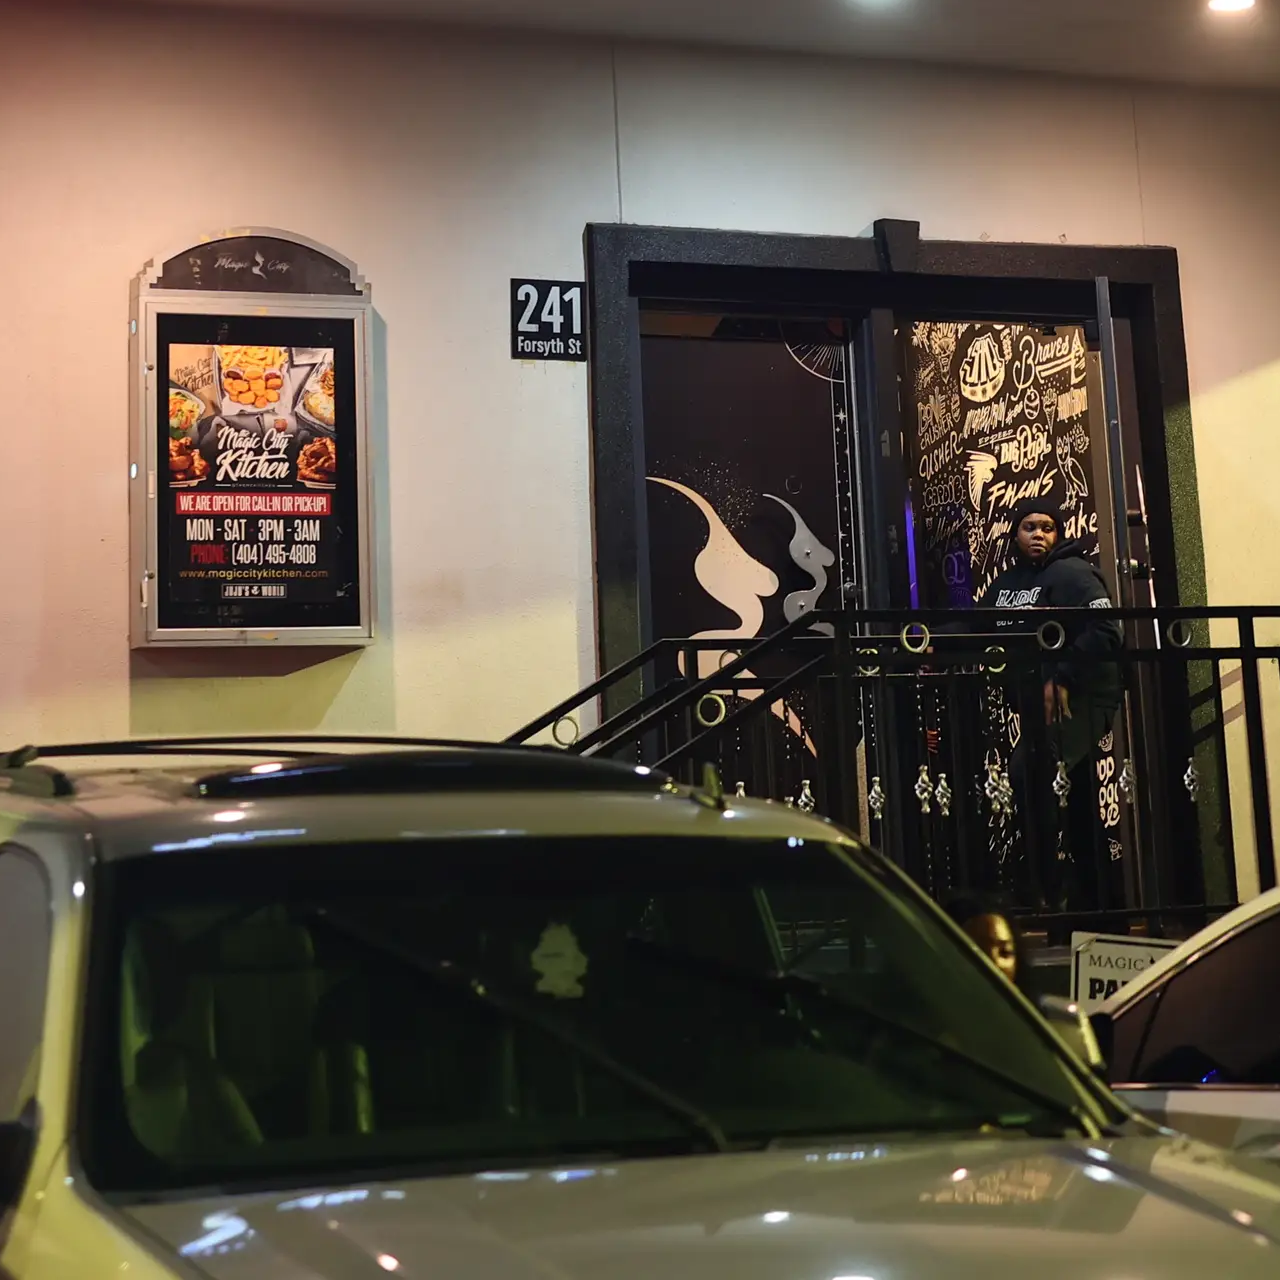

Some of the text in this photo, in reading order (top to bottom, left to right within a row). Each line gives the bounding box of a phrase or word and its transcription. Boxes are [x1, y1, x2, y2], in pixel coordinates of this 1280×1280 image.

[516, 284, 582, 334] 241
[517, 336, 582, 356] Forsyth St
[218, 425, 294, 456] Magic City
[216, 449, 290, 481] Kitchen
[180, 495, 327, 512] WE ARE OPEN FOR CALL-IN OR PICK-UP!
[186, 518, 214, 541] MON
[224, 518, 247, 541] SAT
[258, 519, 284, 542] 3PM
[294, 519, 320, 542] 3AM
[232, 542, 263, 566] (404)
[265, 544, 316, 565] 495-4808
[179, 568, 329, 581] www.magiccitykitchen.com
[1088, 954, 1145, 971] MAGIC
